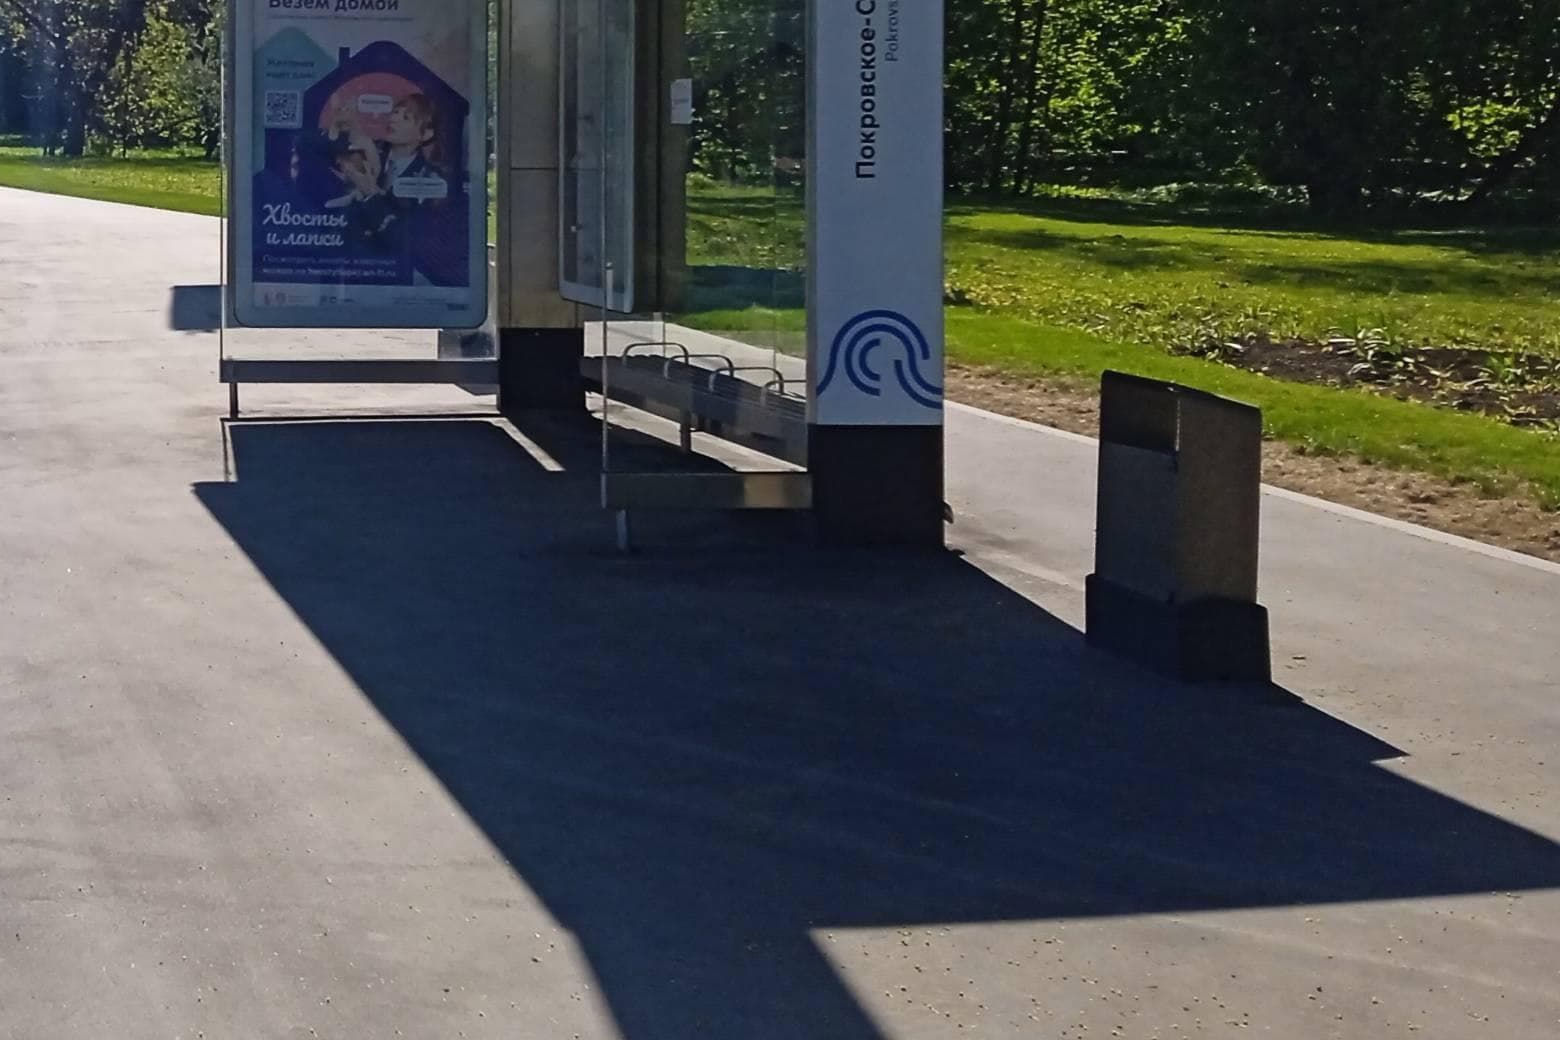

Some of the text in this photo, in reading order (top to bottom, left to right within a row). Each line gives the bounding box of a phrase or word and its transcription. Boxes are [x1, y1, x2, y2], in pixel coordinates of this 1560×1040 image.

[262, 202, 348, 227] Хвосты
[266, 232, 344, 246] и лапки
